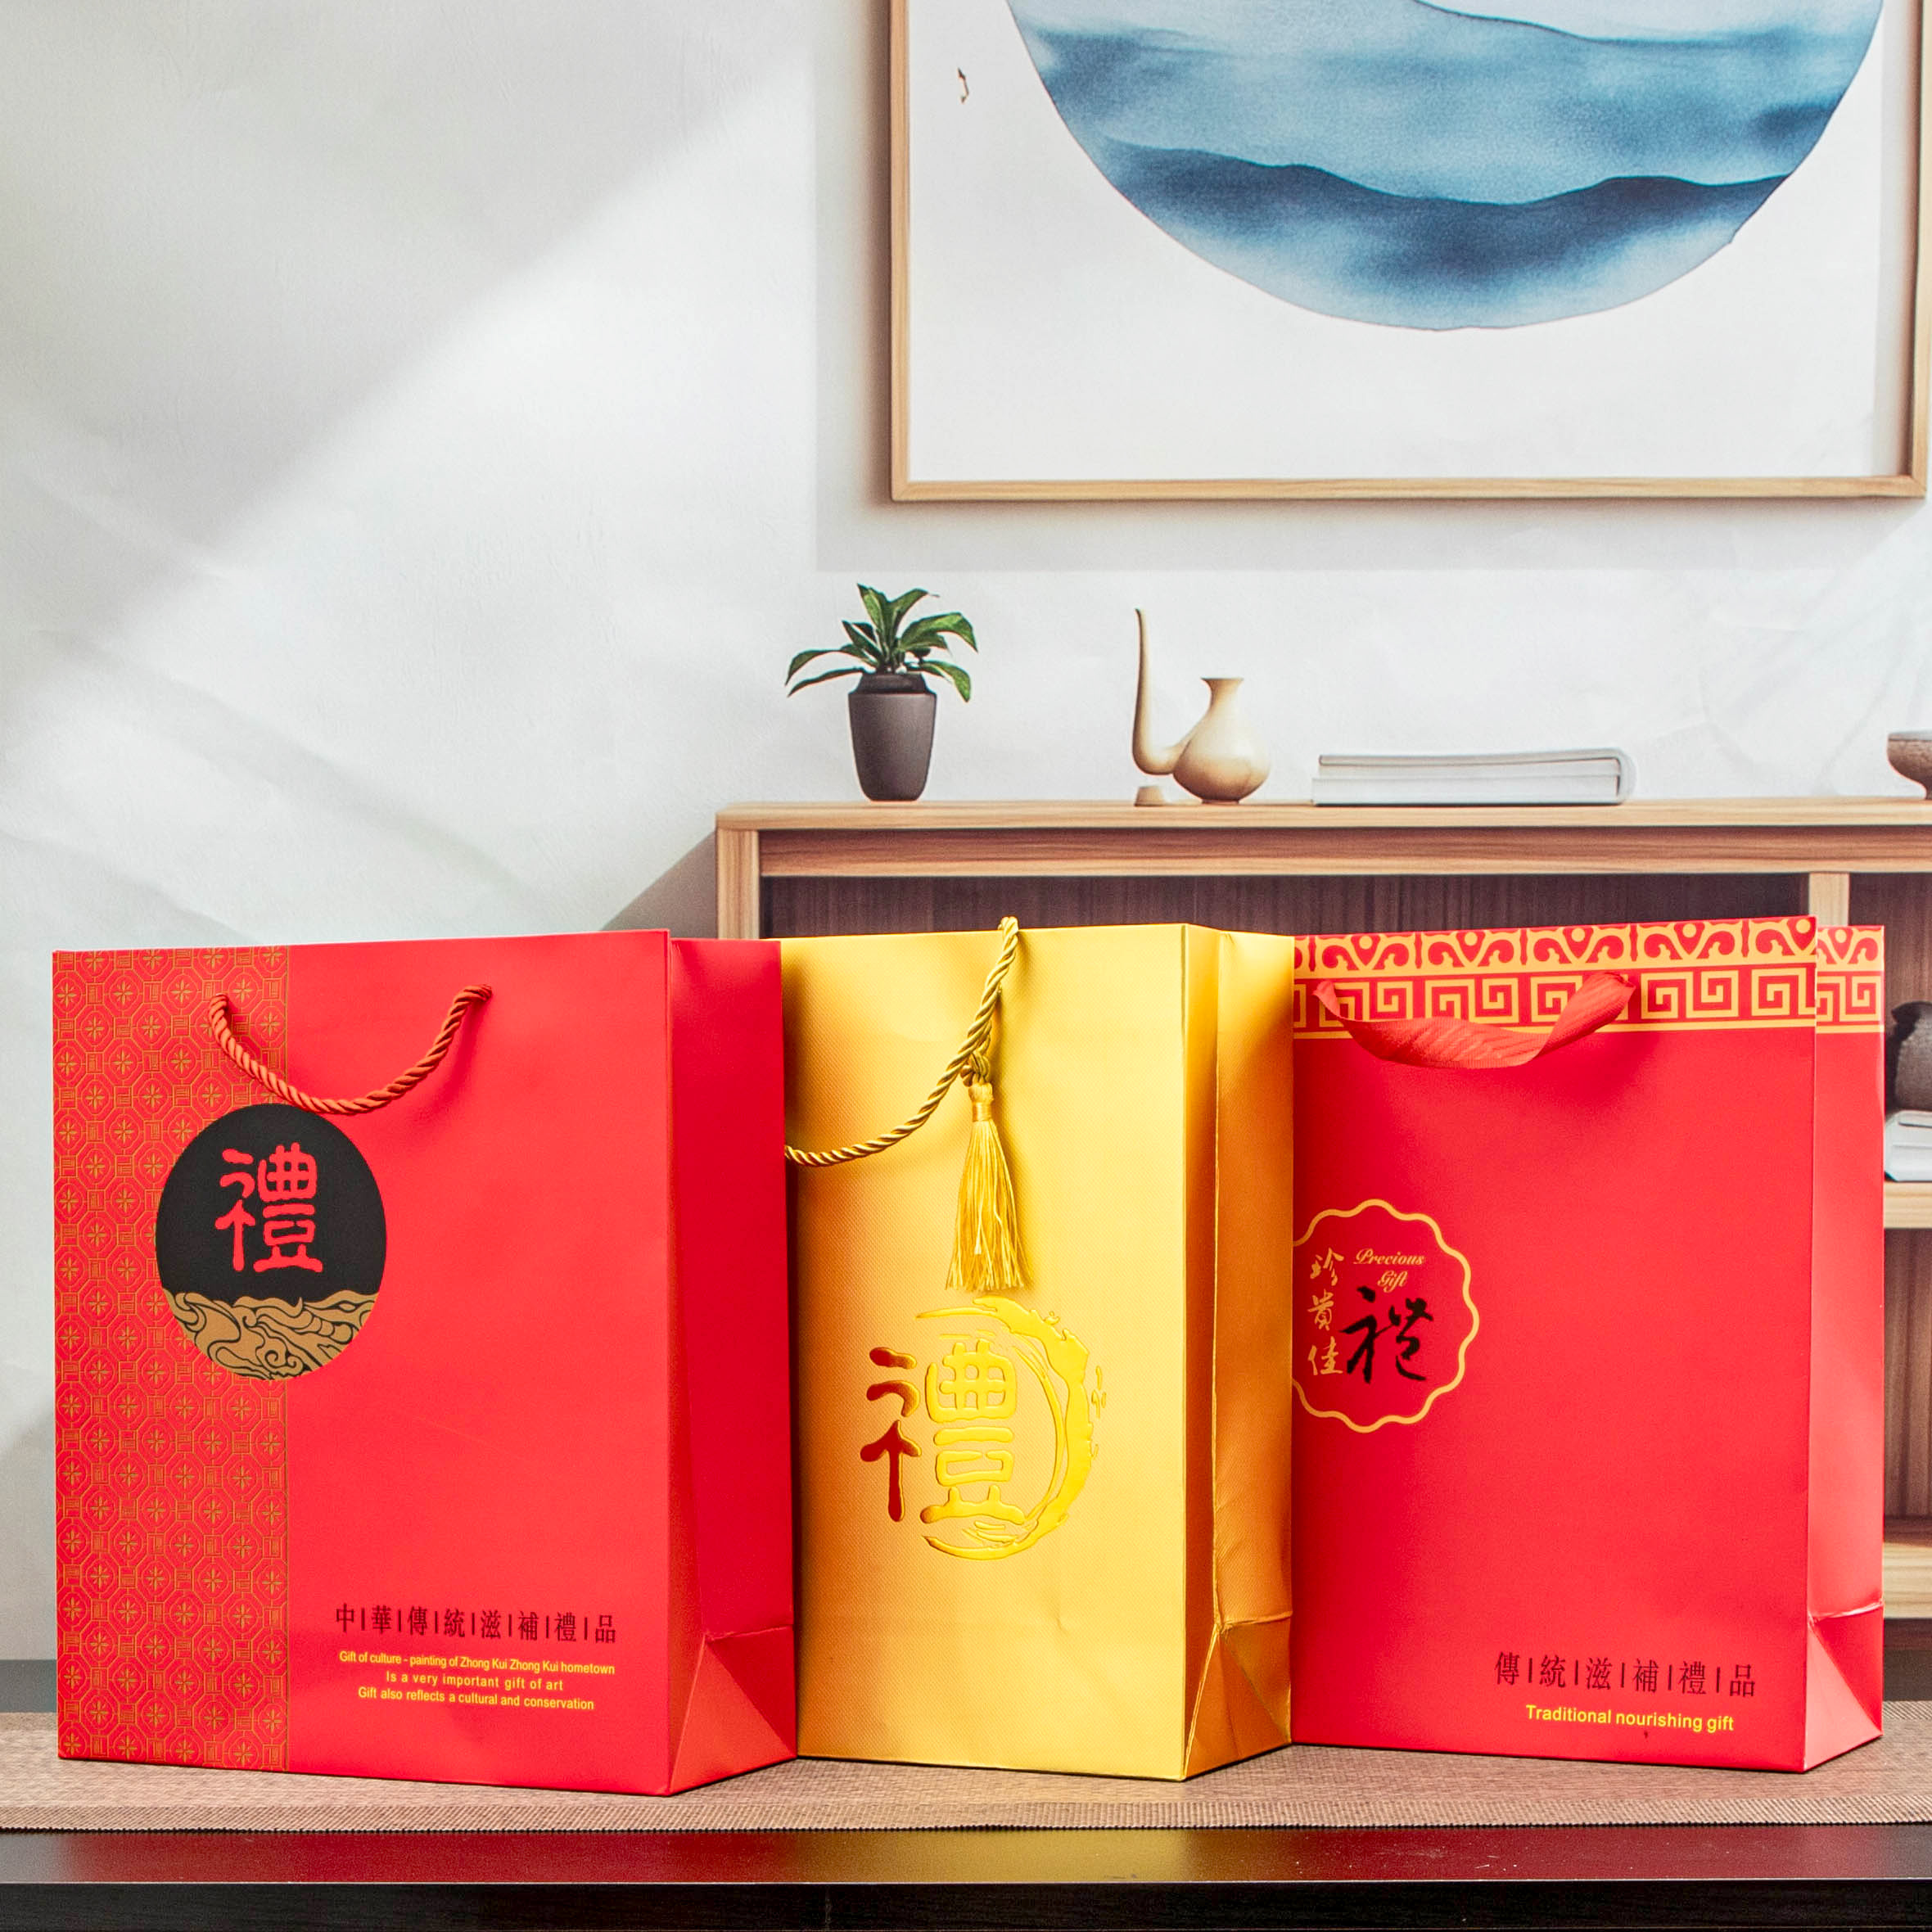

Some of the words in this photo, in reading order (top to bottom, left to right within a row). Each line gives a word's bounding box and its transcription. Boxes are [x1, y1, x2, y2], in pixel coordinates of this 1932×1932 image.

[214, 1142, 323, 1273] 禮
[1352, 1248, 1426, 1266] Precious
[1377, 1270, 1409, 1293] Gift
[860, 1338, 1027, 1525] 禮
[339, 1650, 357, 1663] Gift
[358, 1651, 368, 1663] of
[369, 1653, 402, 1664] culture
[409, 1655, 447, 1669] painting
[449, 1657, 459, 1668] of
[460, 1656, 490, 1671] Zhong
[491, 1658, 508, 1670] Kui
[509, 1659, 540, 1674] Zhong
[542, 1660, 559, 1672] Kui
[560, 1661, 616, 1675] hometown
[386, 1671, 397, 1683] Is
[400, 1673, 409, 1683] a
[412, 1674, 438, 1686] very
[442, 1674, 499, 1688] important
[504, 1677, 526, 1691] gift
[529, 1678, 543, 1690] of
[545, 1680, 564, 1691] art
[358, 1686, 377, 1699] Gift
[380, 1688, 404, 1700] also
[405, 1689, 445, 1703] reflects
[449, 1693, 456, 1703] a
[458, 1692, 498, 1705] cultural
[500, 1695, 521, 1707] and
[523, 1697, 594, 1710] conservation
[1525, 1704, 1613, 1725] Traditional
[1615, 1712, 1703, 1733] nourishing
[1706, 1715, 1735, 1734] gift
